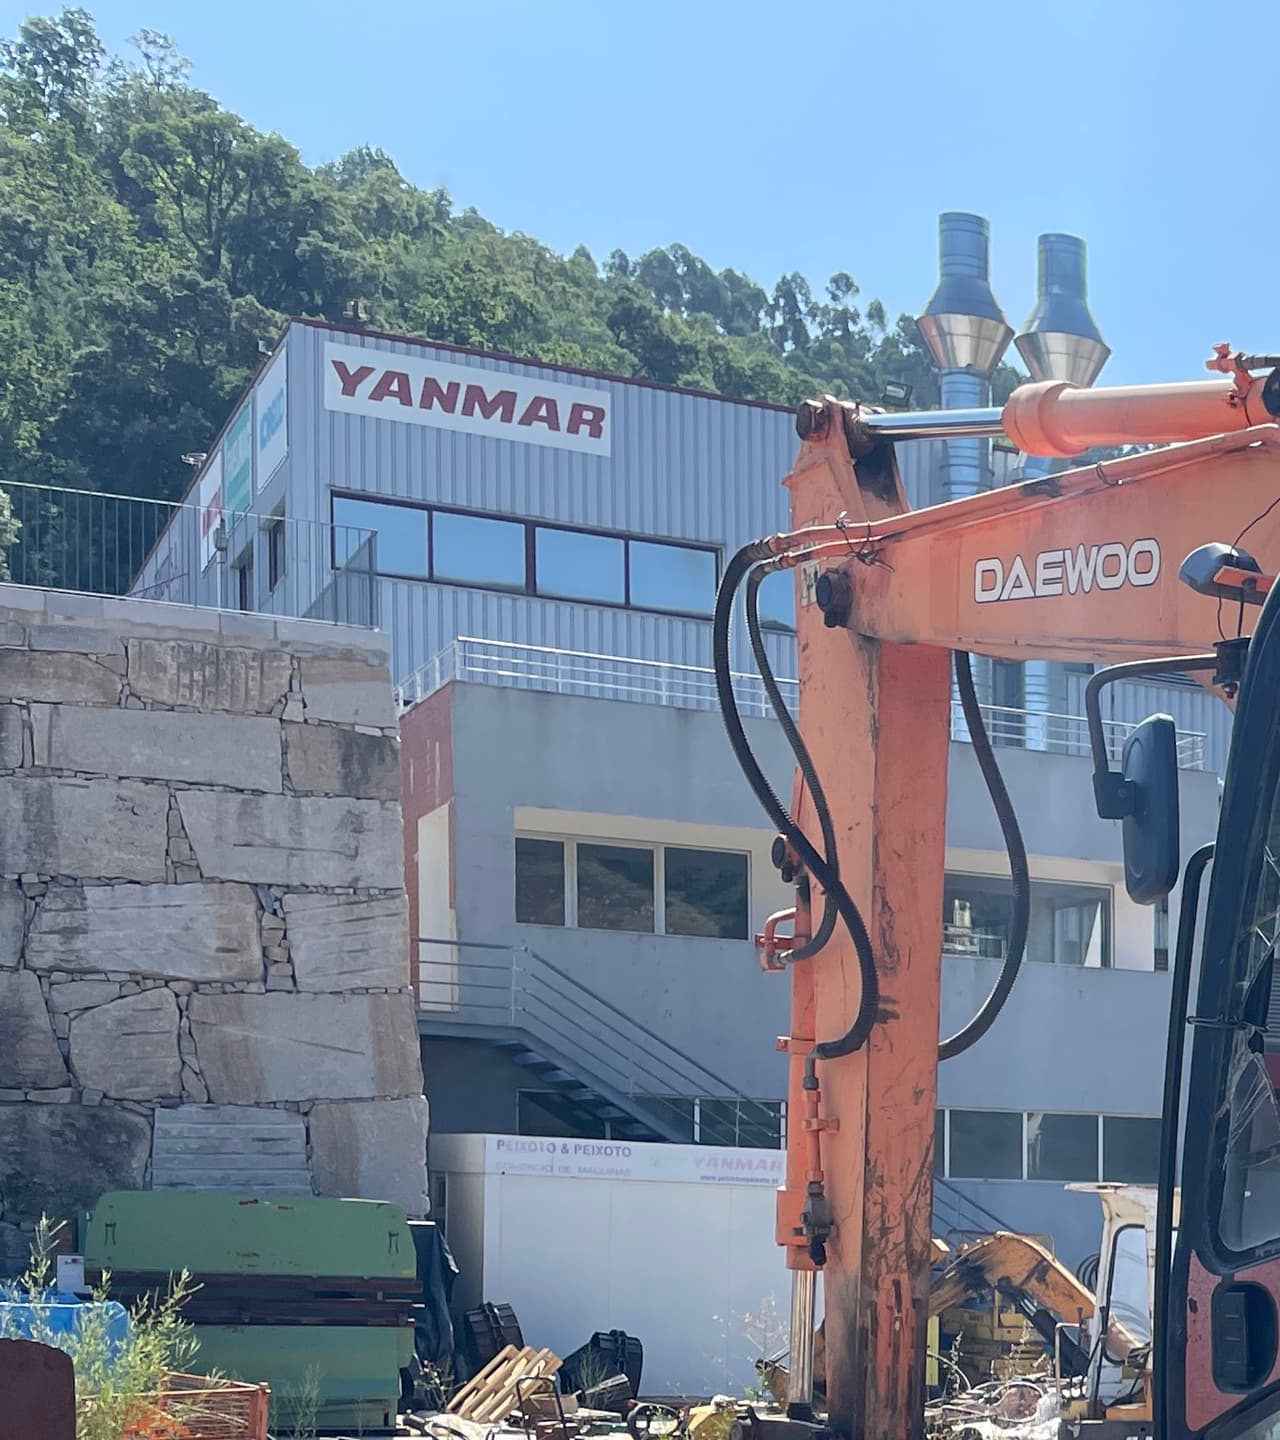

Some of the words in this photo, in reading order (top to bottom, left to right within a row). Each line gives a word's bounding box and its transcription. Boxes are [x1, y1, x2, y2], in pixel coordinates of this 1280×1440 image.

[331, 360, 606, 439] YANMAR
[974, 538, 1161, 604] DAEWOO
[496, 1139, 557, 1153] PEIXOTO
[560, 1143, 570, 1154] &
[574, 1144, 632, 1157] PEIXOTO
